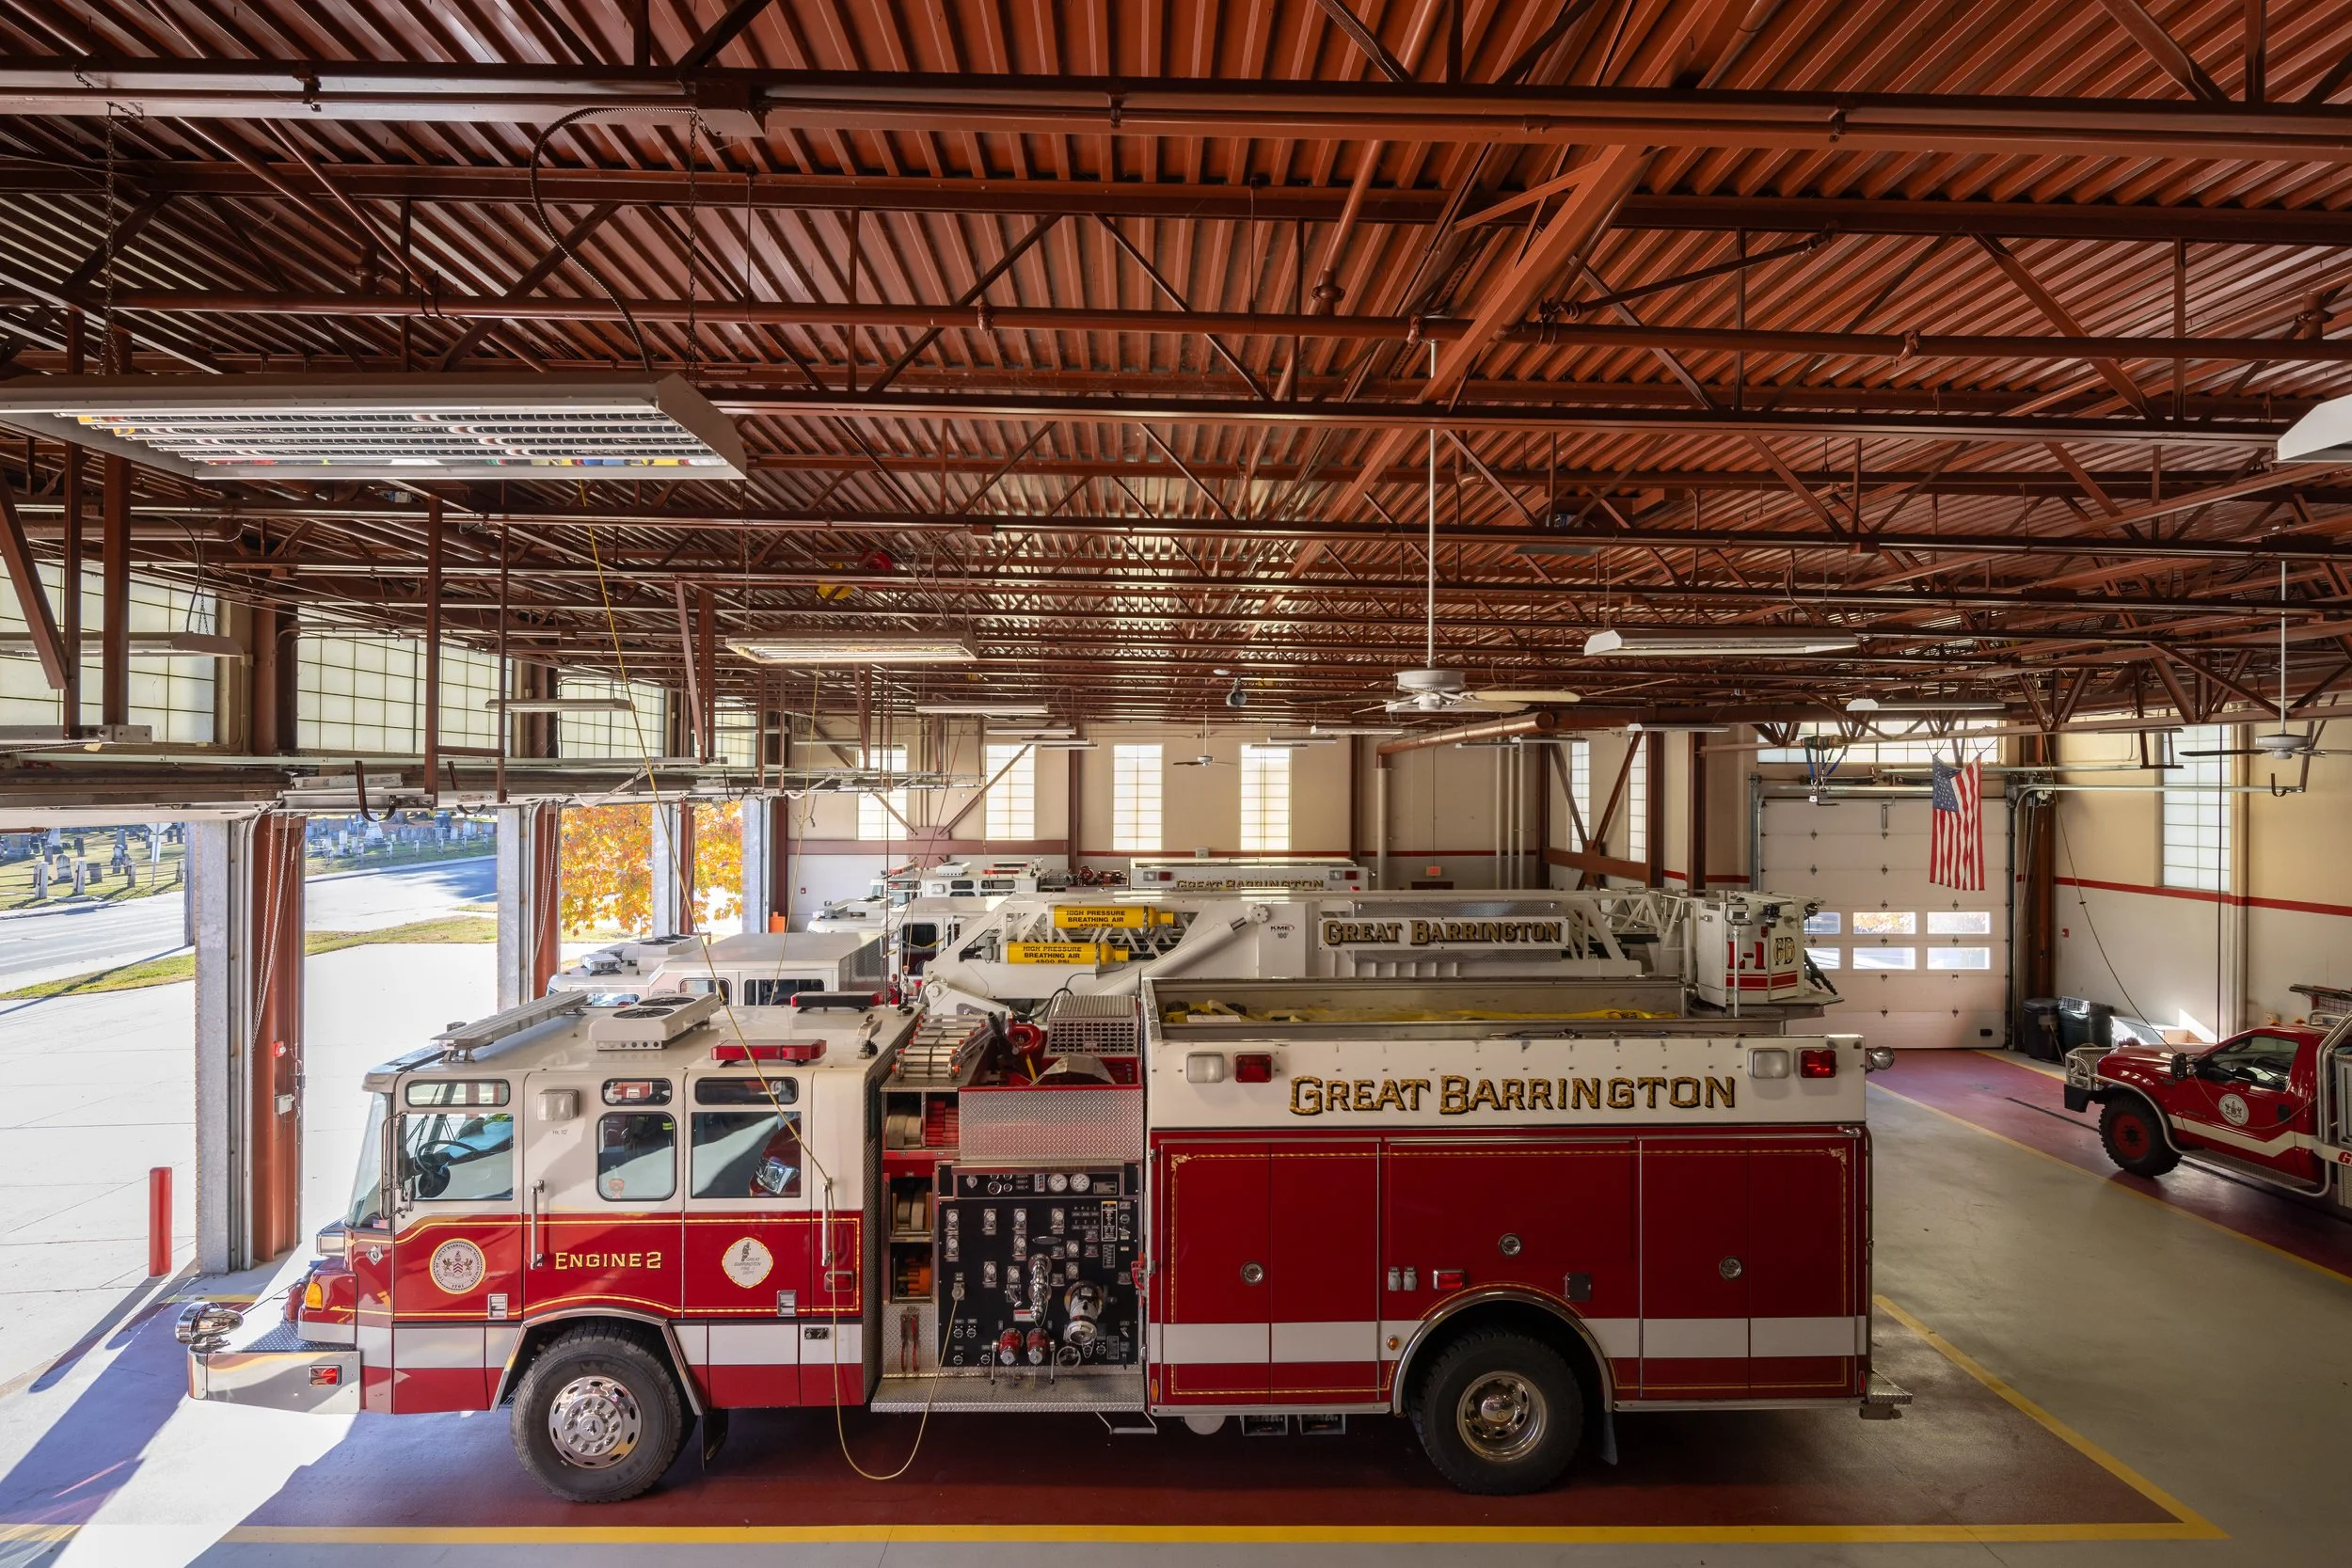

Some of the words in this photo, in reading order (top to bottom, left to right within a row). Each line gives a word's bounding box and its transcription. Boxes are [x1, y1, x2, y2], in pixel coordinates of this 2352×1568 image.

[1323, 919, 1404, 946] GREAT
[1409, 919, 1565, 946] BARRINGTON
[1289, 1074, 1430, 1116] GREAT
[1438, 1074, 1736, 1116] BARRINGTON
